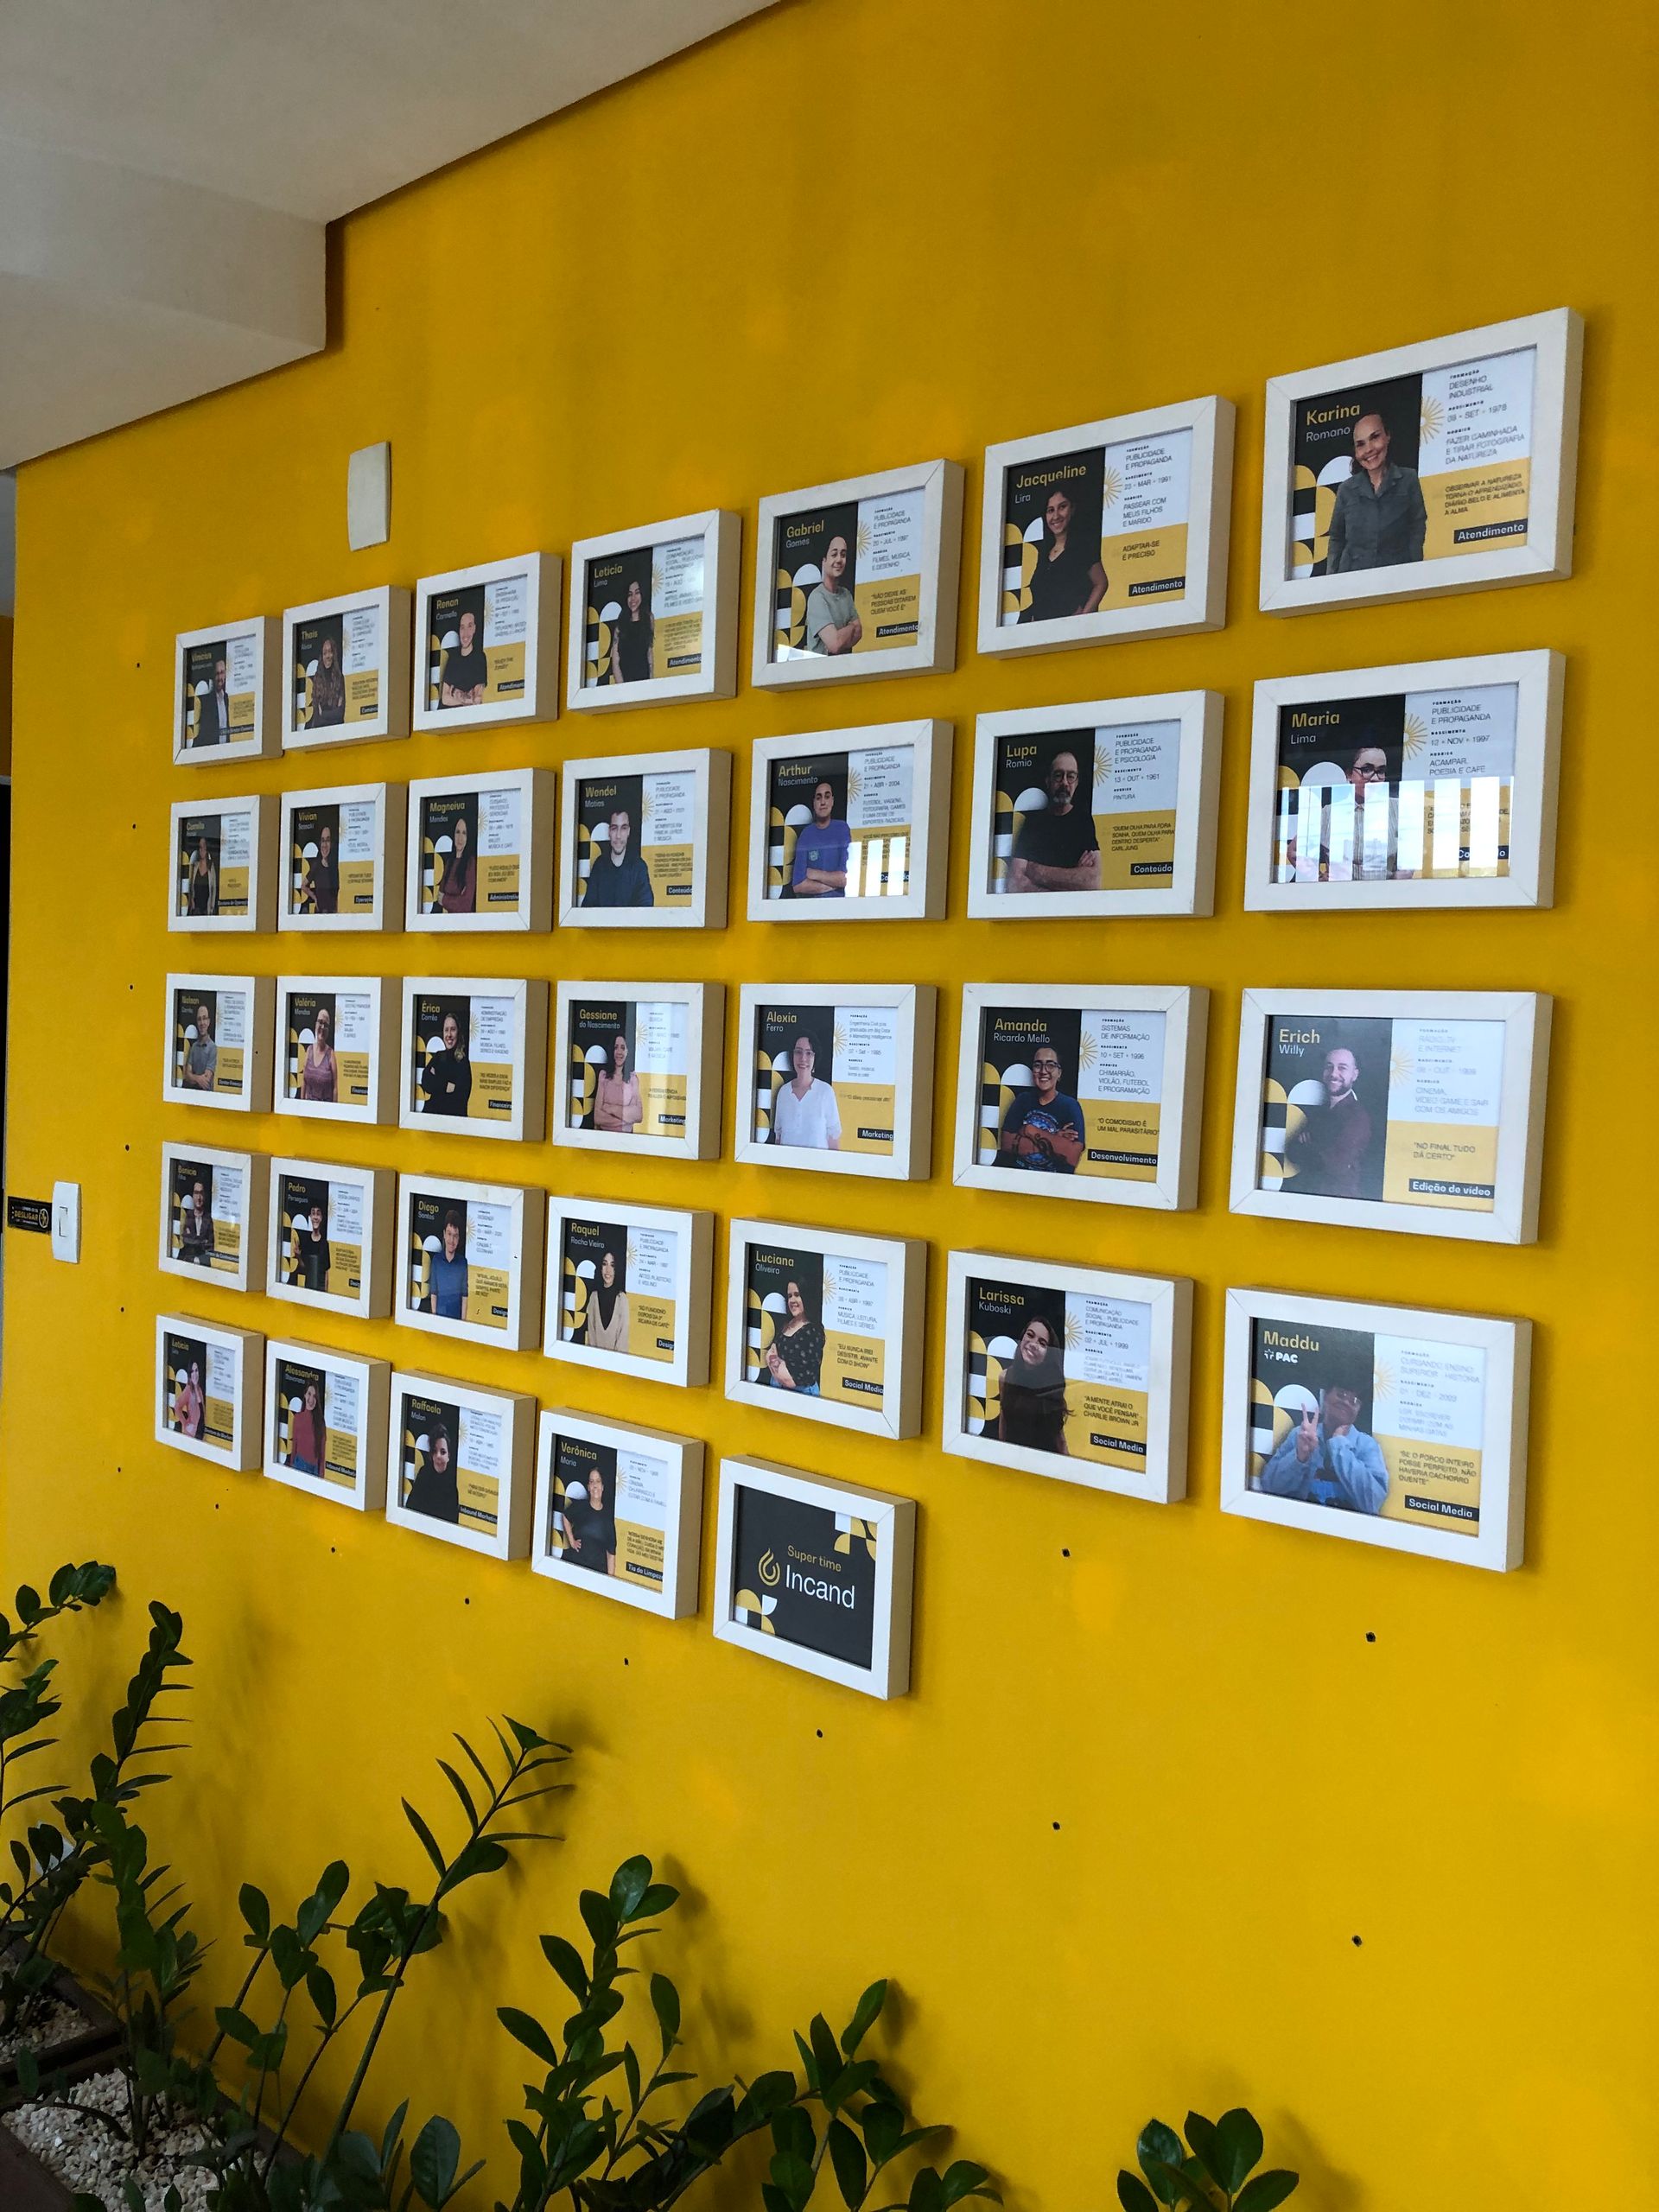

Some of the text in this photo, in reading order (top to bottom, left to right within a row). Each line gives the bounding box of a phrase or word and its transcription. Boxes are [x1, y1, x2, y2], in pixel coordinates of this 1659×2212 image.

[1449, 375, 1487, 390] DESENHO
[1449, 384, 1493, 399] INDUSTRIAL
[1306, 402, 1361, 426] Karina
[1306, 425, 1351, 442] Romano
[1471, 425, 1518, 442] CAMINHADA
[1477, 434, 1525, 448] FOTOGRAFIA
[1126, 448, 1166, 461] PUBLICIDADE
[1131, 455, 1173, 467] PROPAGANDA
[1016, 465, 1087, 489] Jacqueline
[1014, 493, 1031, 505] Lira
[1124, 500, 1150, 510] PASSEAR
[1141, 505, 1163, 515] FILHOS
[1128, 516, 1152, 526] MARIDO
[786, 519, 825, 538] Gabriel
[1458, 524, 1524, 541] Atendimento
[785, 538, 810, 549] Gomes
[1122, 540, 1160, 553] ADAPTAR-SE
[1128, 550, 1156, 560] PRECISO
[1132, 581, 1183, 594] Atendimento
[436, 597, 460, 610] Renan
[878, 623, 918, 636] Atendimento
[1432, 704, 1482, 715] PUBLICIDADE
[1292, 710, 1340, 729] Maria
[1438, 713, 1491, 724] PROPAGANDA
[1116, 738, 1154, 747] PUBLICIDADE
[1290, 734, 1316, 746] Lima
[1472, 734, 1491, 743] 1997
[1007, 745, 1037, 760] Lupa
[1121, 746, 1162, 755] PROPAGANDA
[1005, 760, 1032, 769] Romio
[1120, 754, 1156, 763] PSICOLOGIA
[779, 764, 813, 778] Arthur
[778, 776, 818, 787] Nascimento
[585, 785, 617, 798] Wendel
[1113, 792, 1136, 801] PINTURA
[1134, 865, 1173, 874] Conteúdo
[421, 1000, 441, 1014] Érica
[579, 1007, 618, 1020] Gessiane
[766, 1011, 798, 1024] Alexia
[588, 1020, 621, 1030] Nascimento
[766, 1023, 784, 1033] Ferro
[994, 1018, 1047, 1033] Amanda
[993, 1032, 1051, 1044] Ricardo Mello
[1111, 1033, 1151, 1042] INFORMAÇÃO
[1279, 1028, 1320, 1045] Erich
[1279, 1044, 1305, 1058] Willy
[1122, 1078, 1149, 1087] FUTEBOL
[1103, 1085, 1151, 1096] PROGRAMAÇÃO
[1105, 1118, 1141, 1127] COMODISMO
[862, 1129, 894, 1141] Marketing
[1429, 1142, 1452, 1152] FINAL
[1453, 1144, 1476, 1154] TUDO
[1091, 1151, 1157, 1165] Desenvolvimento
[288, 1181, 307, 1193] Pedro
[1412, 1180, 1491, 1197] Edição de vídeo
[417, 1199, 440, 1215] Diego
[15, 1210, 39, 1220] DESLIGAR
[570, 1222, 601, 1237] Raquel
[570, 1236, 605, 1249] Rocha Vieira
[755, 1250, 794, 1268] Luciana
[754, 1263, 781, 1274] Oliveira
[978, 1287, 1025, 1306] Larissa
[978, 1300, 1012, 1314] Kuboski
[1263, 1331, 1319, 1351] Maddu
[1275, 1351, 1299, 1363] PAC
[844, 1379, 884, 1394] Social Media
[410, 1397, 442, 1415] Raffaela
[1084, 1402, 1096, 1411] QUE
[1097, 1406, 1114, 1414] VOCÊ
[1083, 1410, 1108, 1421] CHARLIE
[1109, 1415, 1131, 1425] BROWN
[561, 1440, 597, 1461] Verônica
[1093, 1435, 1145, 1453] Social Media
[560, 1455, 578, 1467] Maria
[1419, 1453, 1446, 1464] PORCO
[1446, 1458, 1475, 1469] INTEIRO
[1398, 1467, 1470, 1484] HAVERIA CACHORRO
[1408, 1497, 1474, 1518] Social Media
[787, 1544, 842, 1573] Super time
[785, 1564, 855, 1610] Incand
